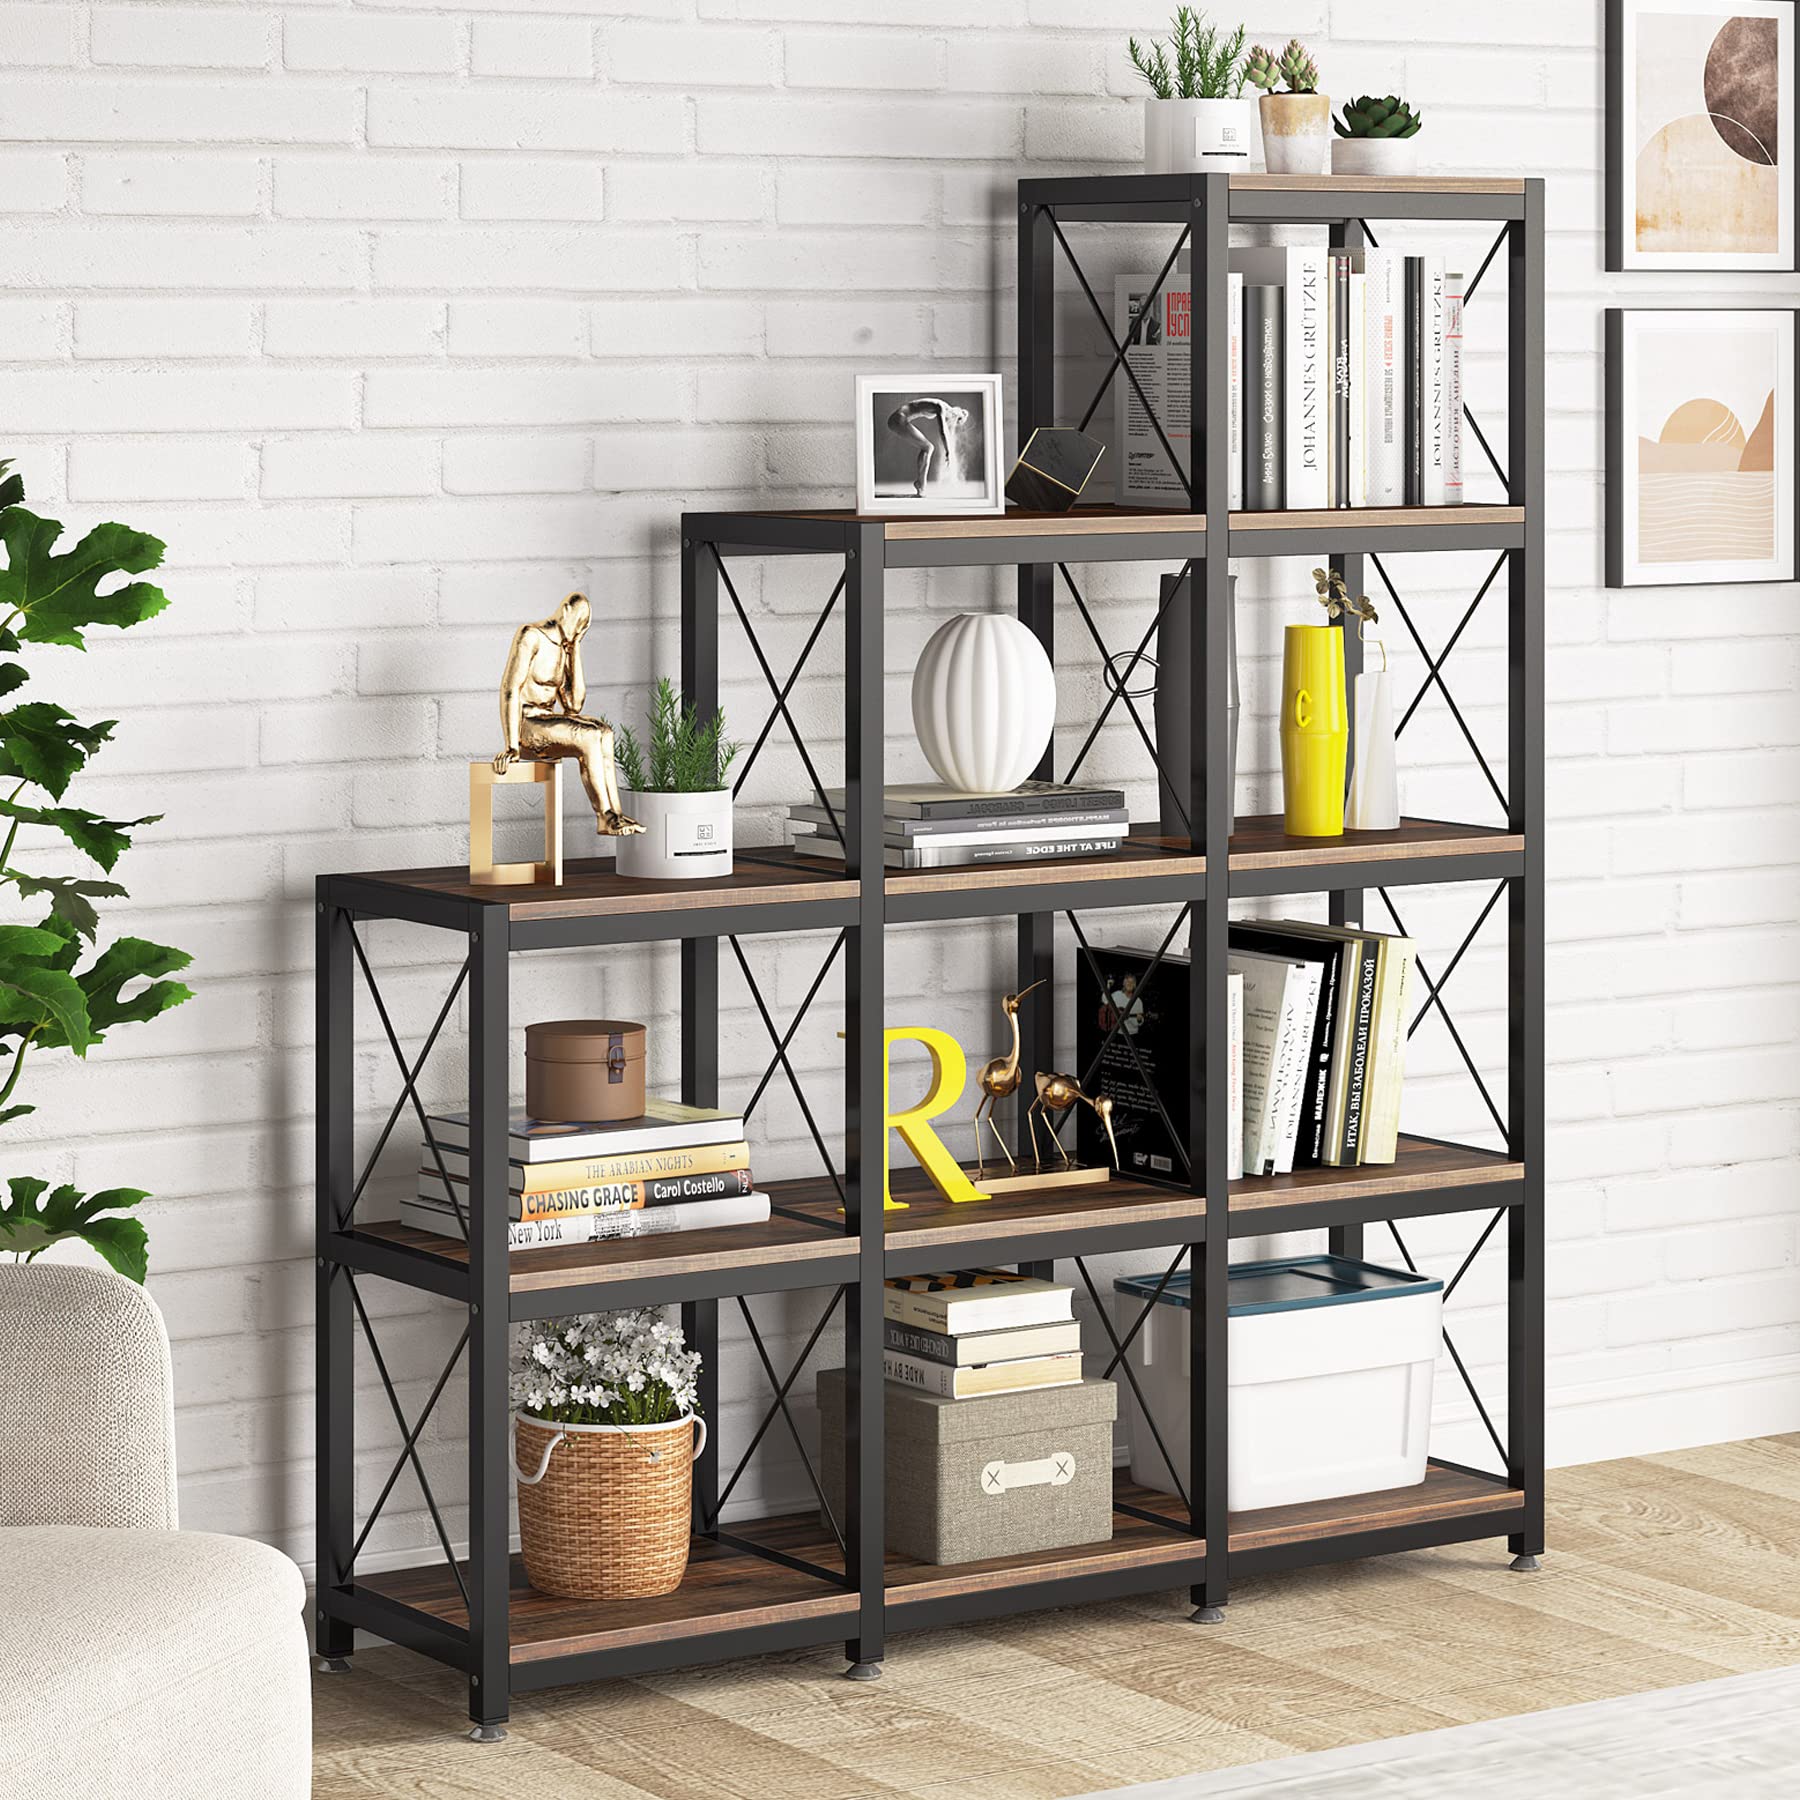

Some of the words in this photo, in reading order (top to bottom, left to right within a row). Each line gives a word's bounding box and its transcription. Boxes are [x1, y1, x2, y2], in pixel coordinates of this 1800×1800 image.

[1301, 262, 1317, 359] GRÜTZKE
[1262, 390, 1275, 424] Сказки
[1301, 363, 1317, 471] JOHANNES
[1432, 367, 1442, 469] JOHANNES
[1262, 432, 1275, 460] Бялко
[1262, 462, 1274, 484] Анна
[1359, 958, 1376, 1024] ПРОКАЗОЙ
[1352, 1026, 1368, 1089] ЗАБОЛЕЛИ
[1314, 1069, 1328, 1121] МАЛЕЖИК
[1350, 1091, 1362, 1110] ВЫ
[837, 1026, 992, 1214] R
[1345, 1111, 1360, 1148] ИТАК,
[585, 1164, 606, 1180] THE
[609, 1158, 653, 1179] ARABIAN
[655, 1154, 694, 1174] NIGHTS
[526, 1187, 590, 1216] CHASING
[594, 1182, 640, 1209] GRACE
[653, 1181, 681, 1200] Carol
[683, 1175, 726, 1196] Costello
[508, 1220, 535, 1246] New
[537, 1218, 563, 1243] York
[893, 1362, 904, 1381] BY
[904, 1364, 925, 1385] MADE
